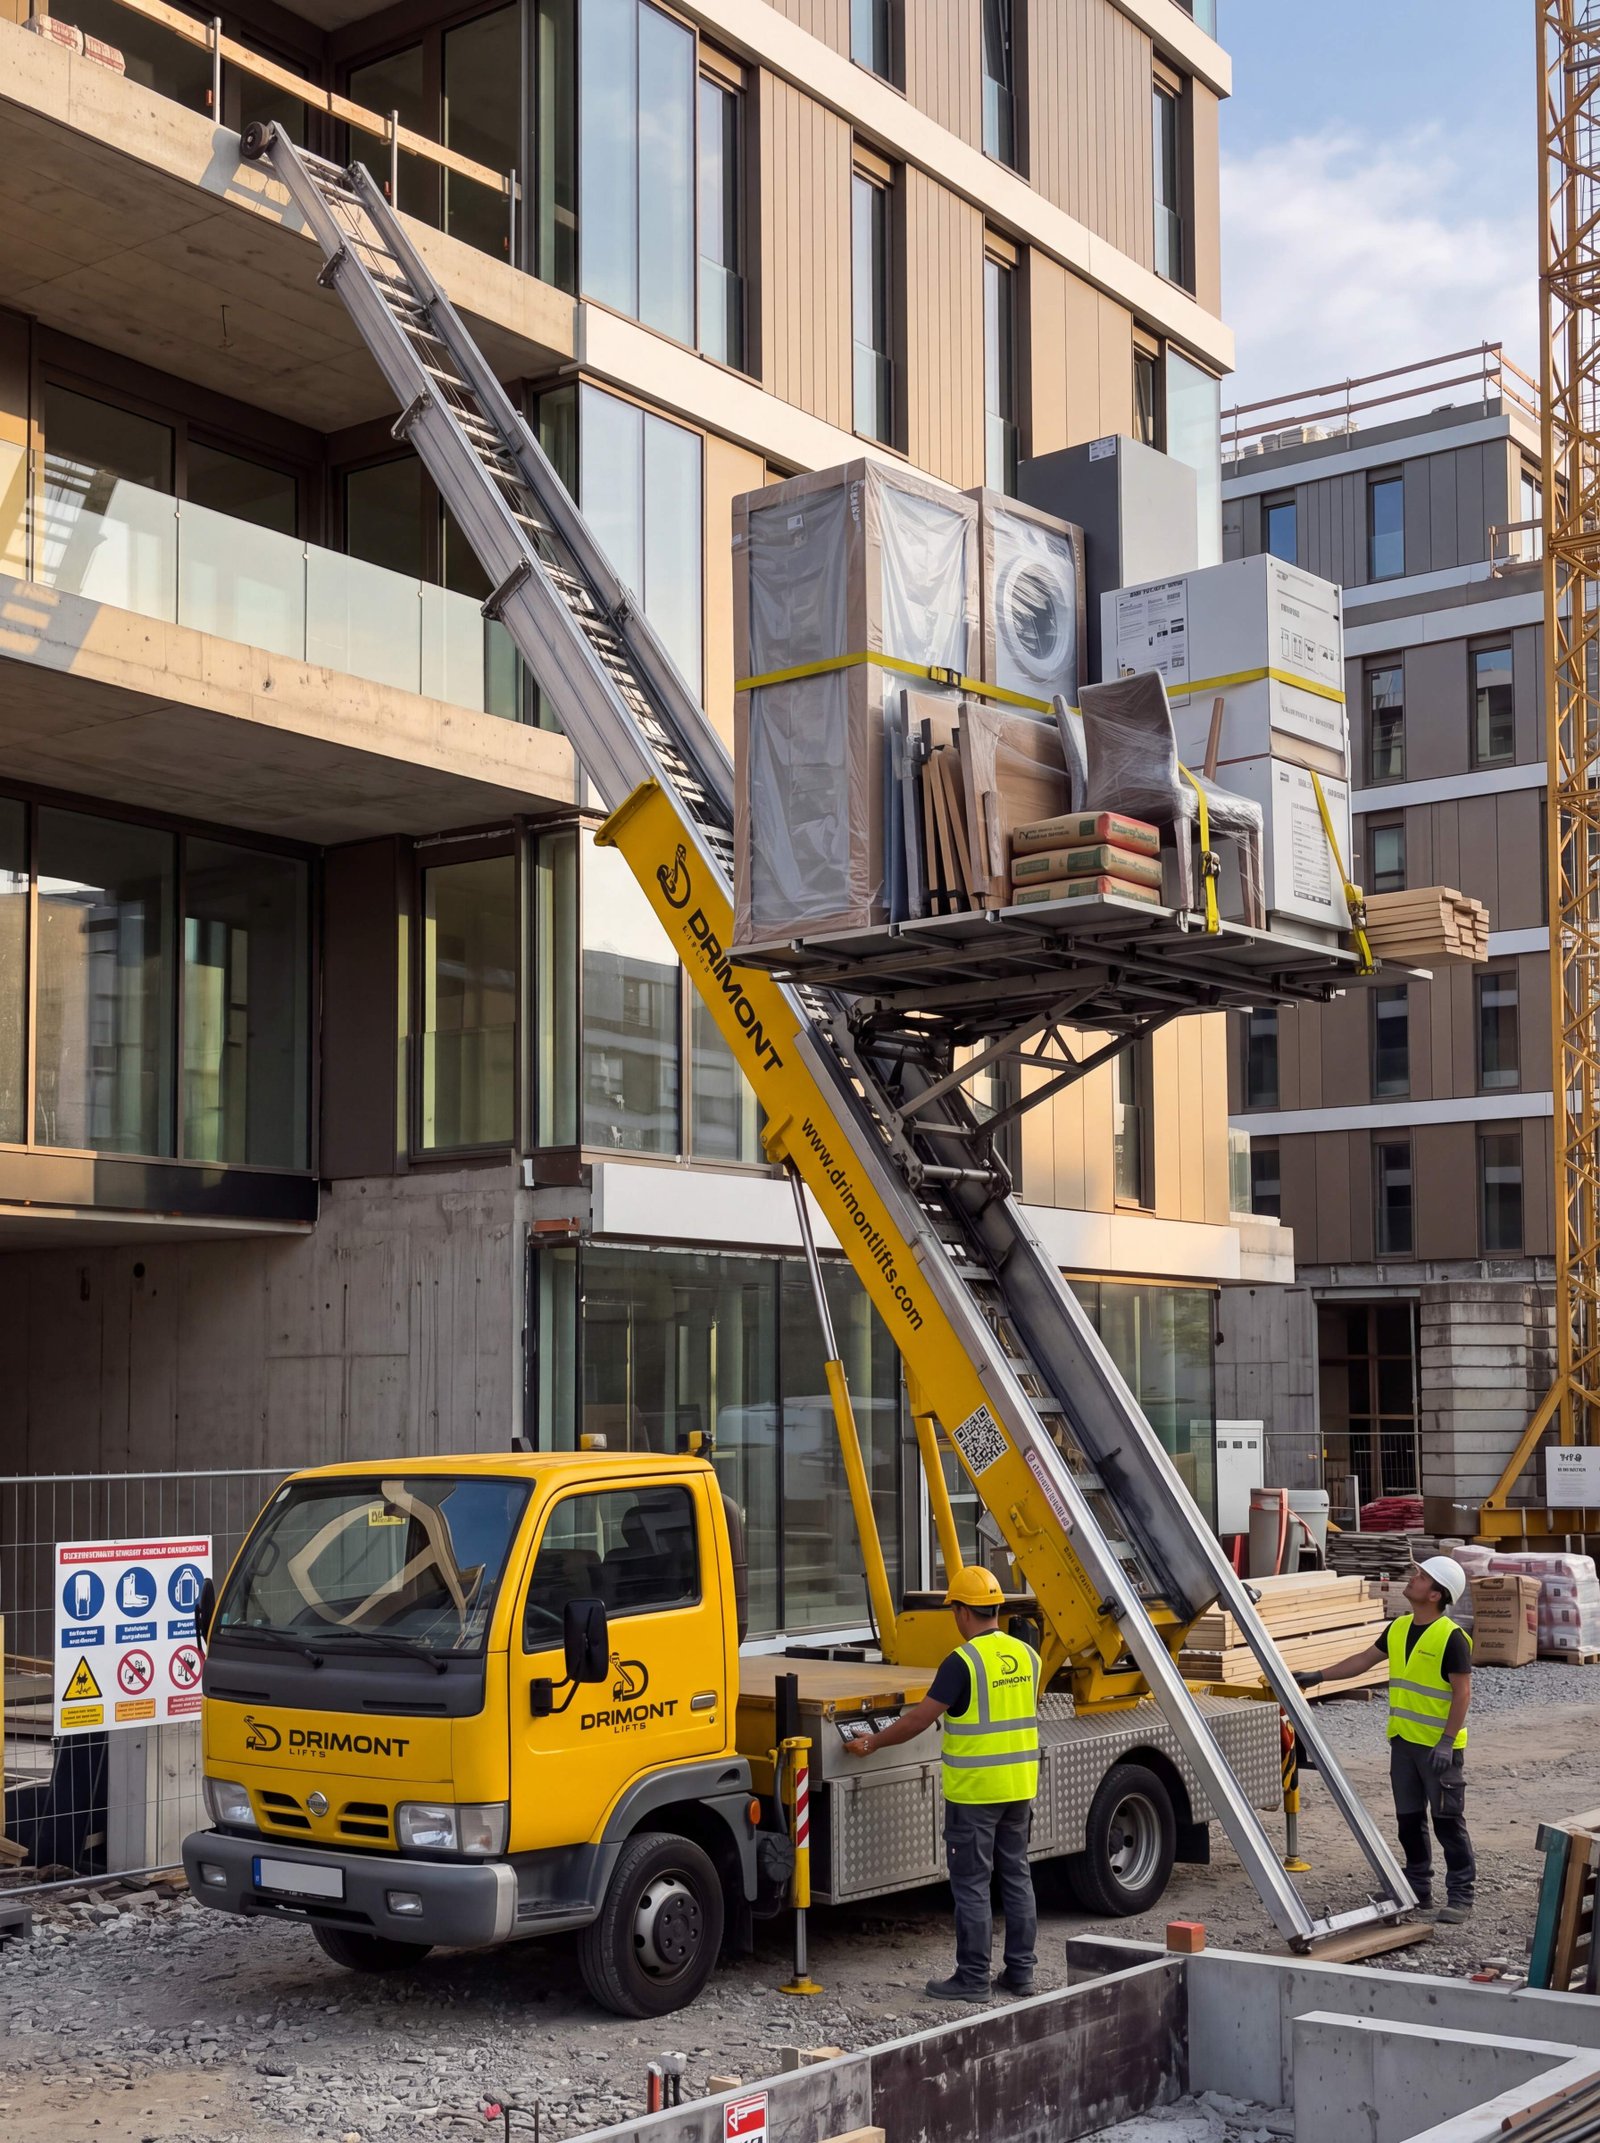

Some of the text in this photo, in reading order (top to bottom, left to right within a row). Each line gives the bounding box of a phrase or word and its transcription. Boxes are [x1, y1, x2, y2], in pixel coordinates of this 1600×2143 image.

[687, 907, 783, 1072] DRIMONT
[801, 1117, 924, 1332] www.drimontlifts.com
[580, 1700, 678, 1730] DRIMONT
[614, 1722, 646, 1734] LIFTS
[289, 1729, 410, 1757] DRIMONT
[289, 1748, 326, 1758] LIFTS
